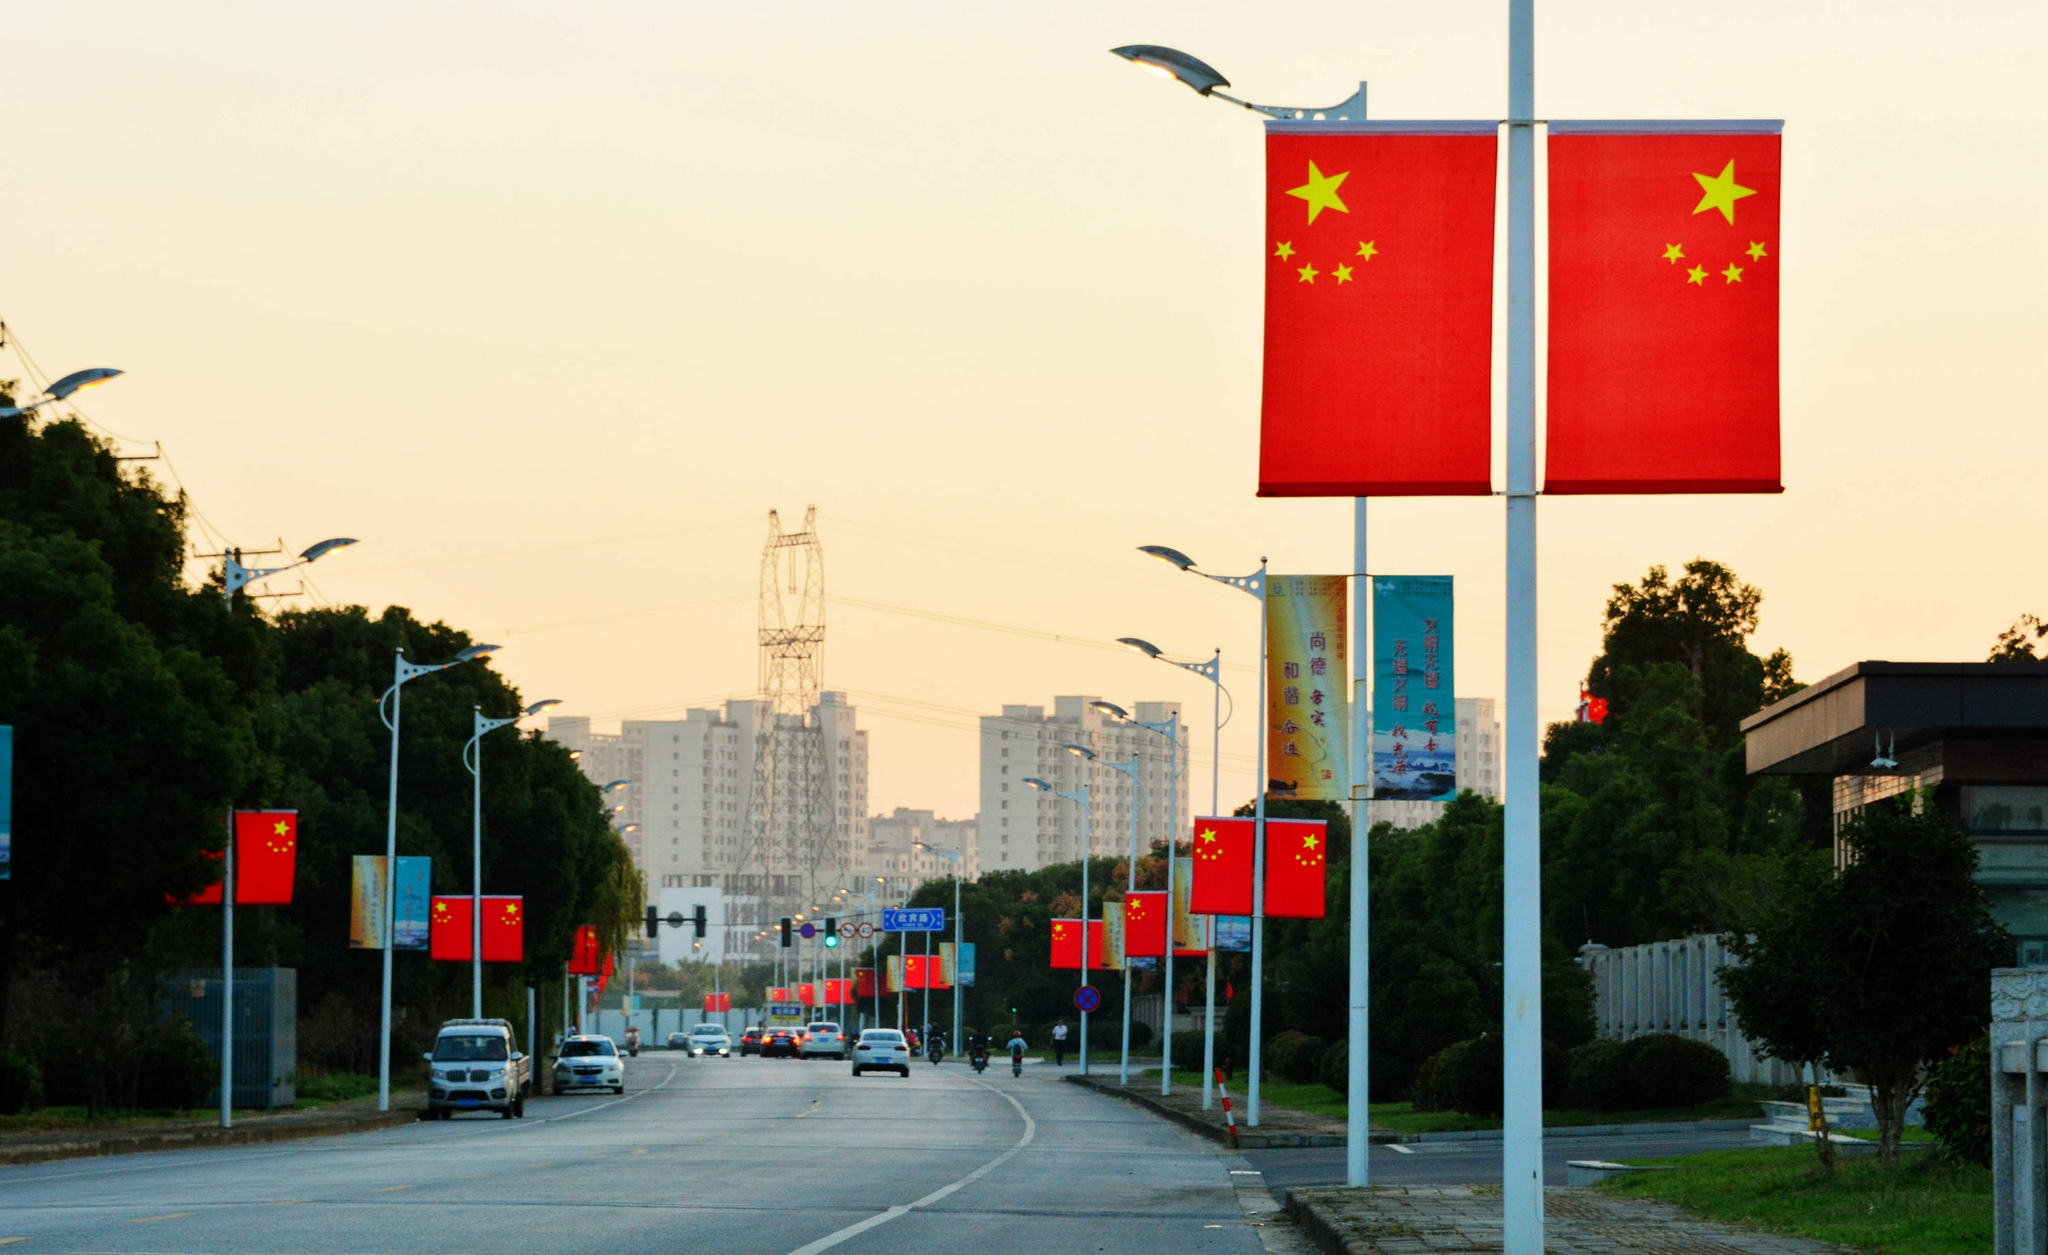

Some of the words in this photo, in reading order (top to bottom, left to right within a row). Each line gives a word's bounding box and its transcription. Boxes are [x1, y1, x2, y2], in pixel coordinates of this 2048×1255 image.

[1310, 631, 1326, 676] 尚德
[1393, 639, 1408, 712] 无锡文明
[1423, 618, 1439, 689] 文明无锡
[1284, 662, 1299, 706] 和谐
